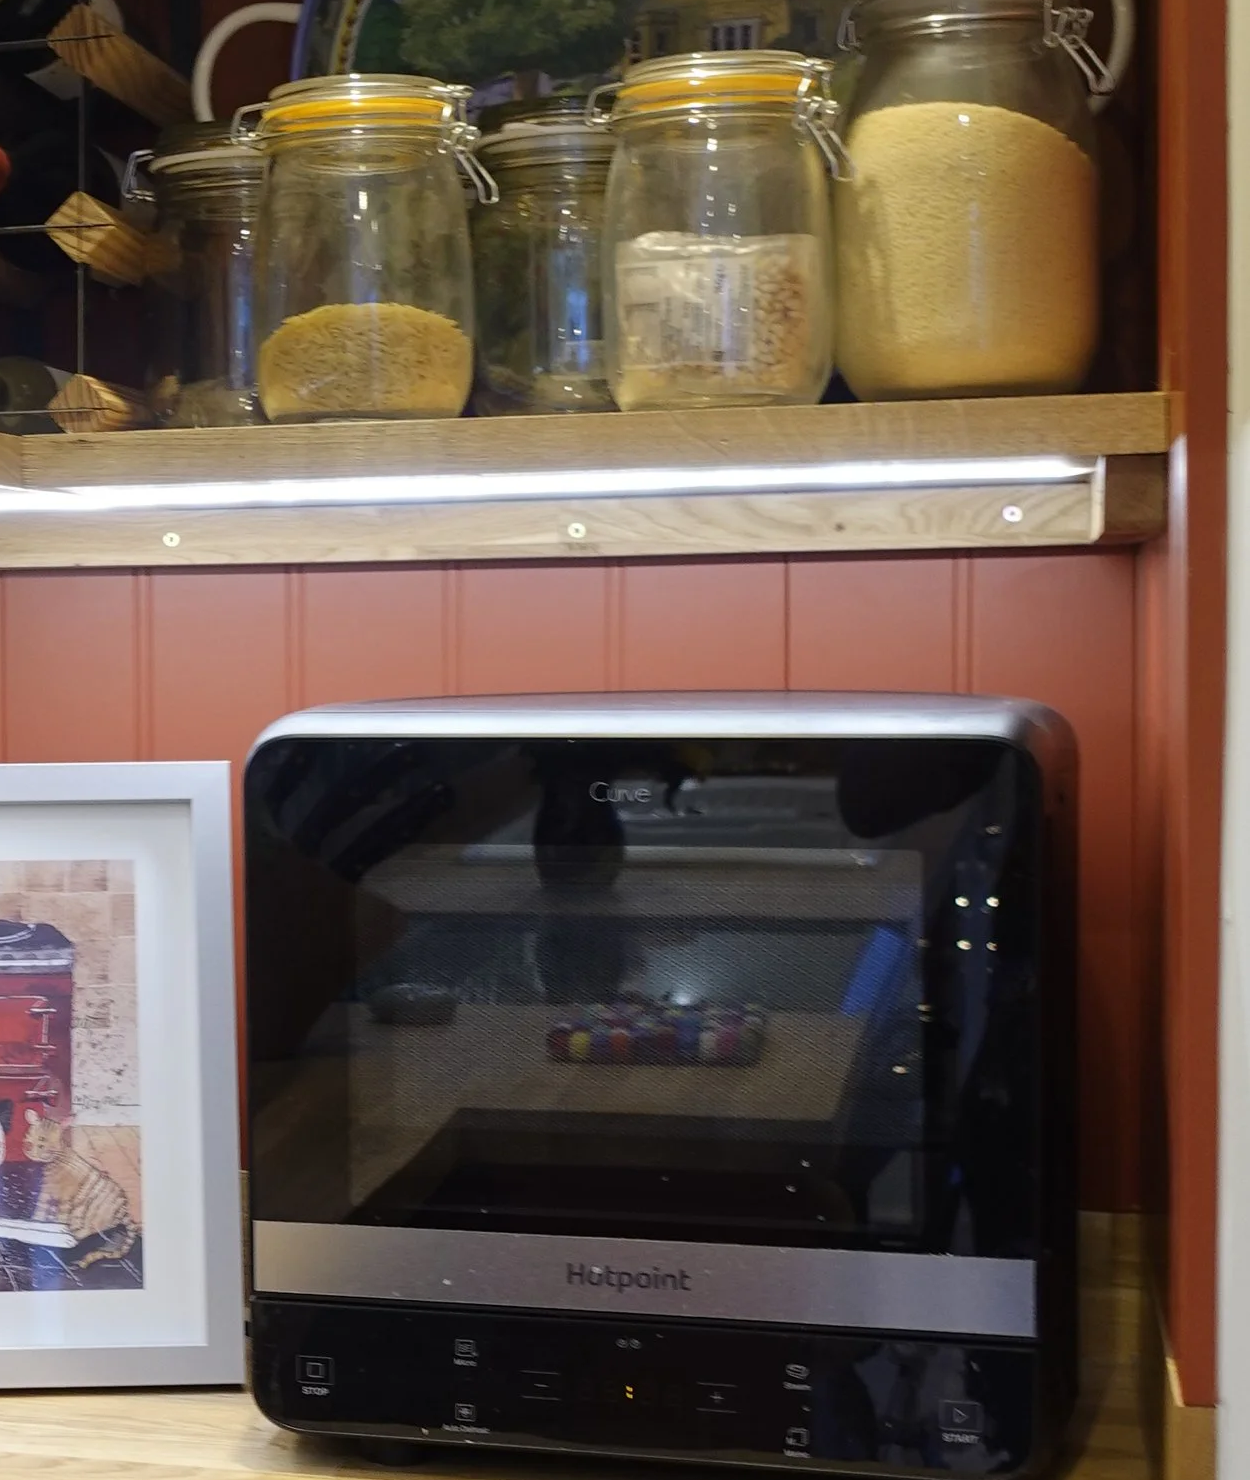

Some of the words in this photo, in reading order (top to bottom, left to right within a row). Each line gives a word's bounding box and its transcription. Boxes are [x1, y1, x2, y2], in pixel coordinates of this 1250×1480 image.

[588, 781, 652, 803] Curve
[565, 1262, 693, 1294] Hotpoint
[301, 1385, 331, 1397] STOP
